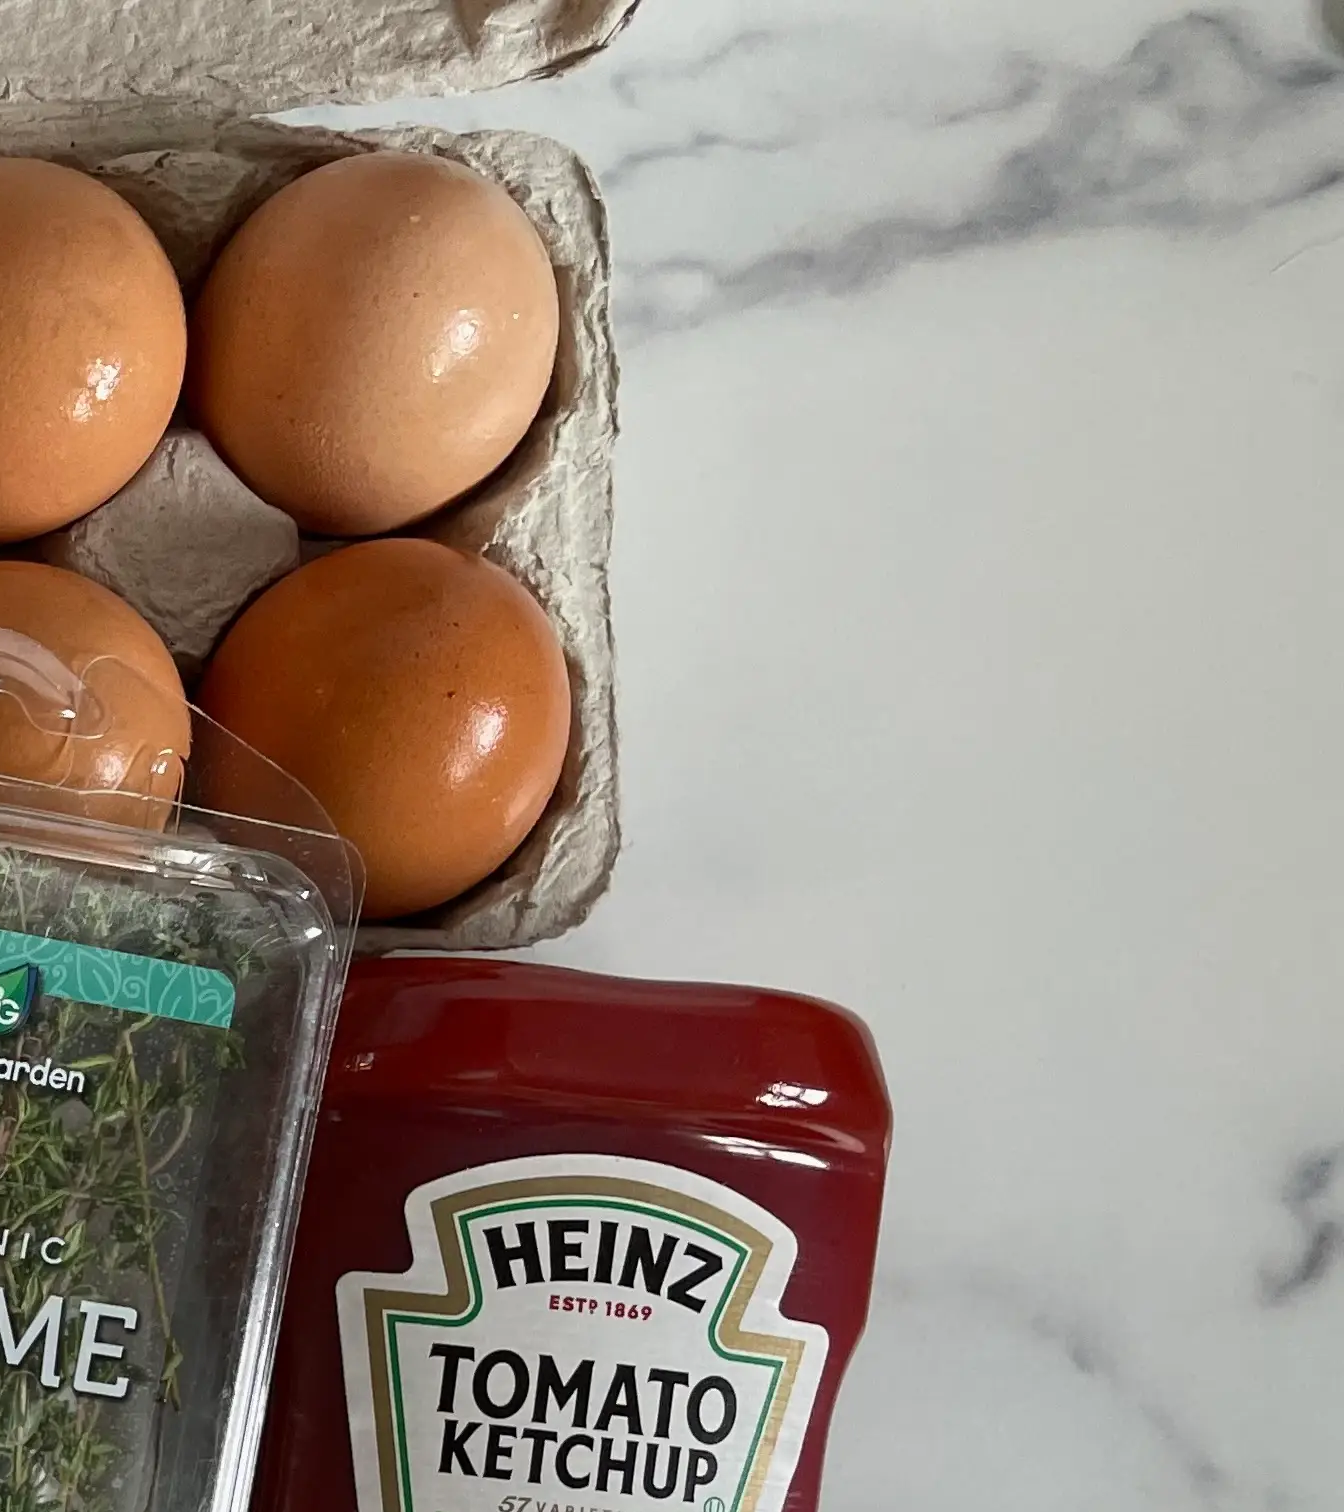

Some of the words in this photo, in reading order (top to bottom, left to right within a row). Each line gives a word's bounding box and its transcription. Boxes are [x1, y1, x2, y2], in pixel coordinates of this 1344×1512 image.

[481, 1218, 724, 1313] HEINZ
[605, 1301, 653, 1321] 1869
[429, 1342, 738, 1445] TOMATO
[437, 1419, 719, 1504] KETCHUP
